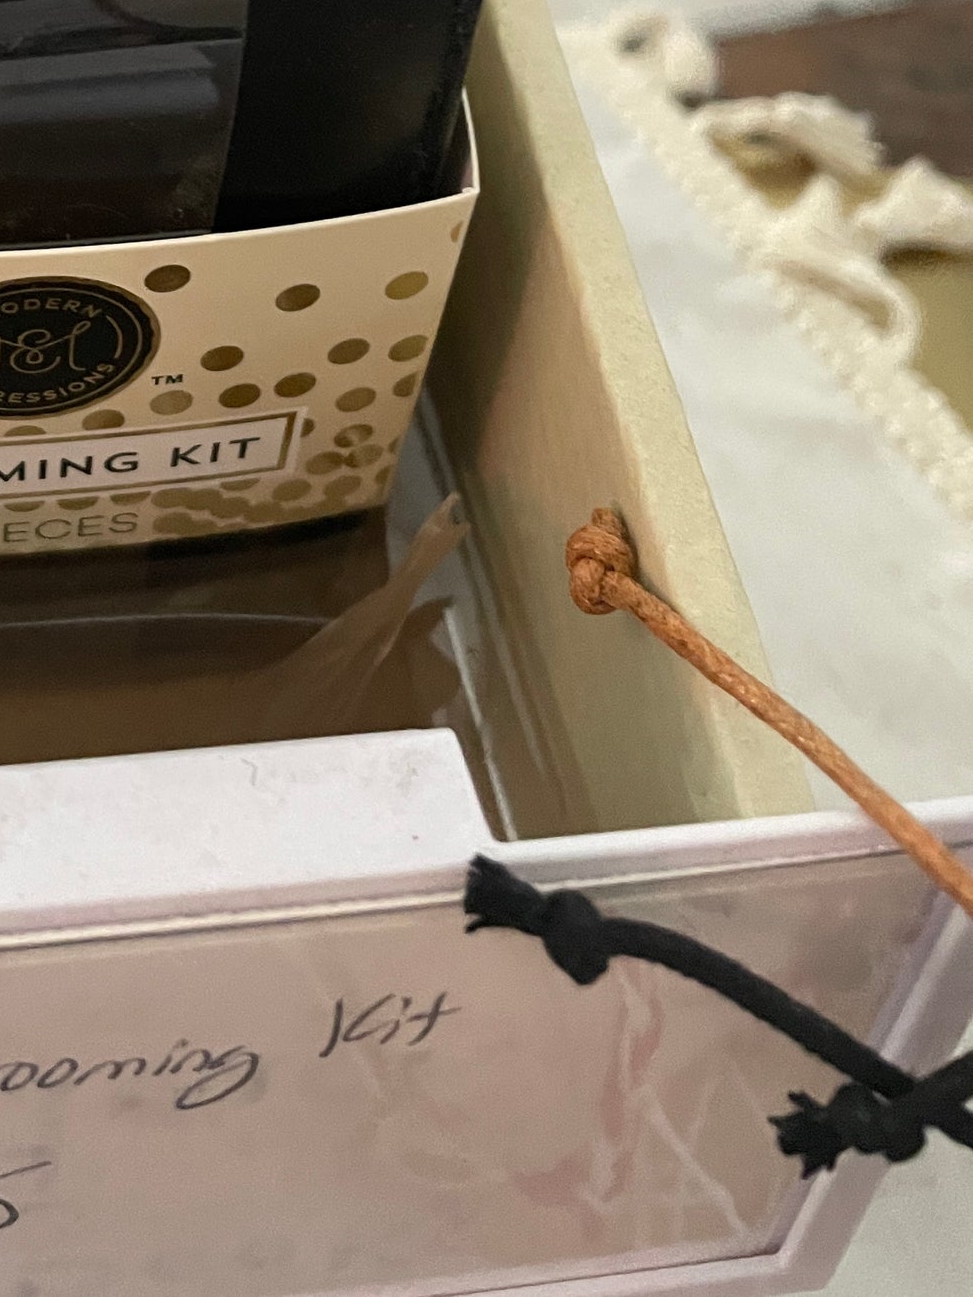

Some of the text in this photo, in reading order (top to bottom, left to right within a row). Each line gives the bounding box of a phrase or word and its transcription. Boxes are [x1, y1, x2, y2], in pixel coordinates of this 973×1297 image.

[151, 374, 184, 386] TM
[169, 435, 262, 469] KIT
[318, 991, 463, 1058] Kit
